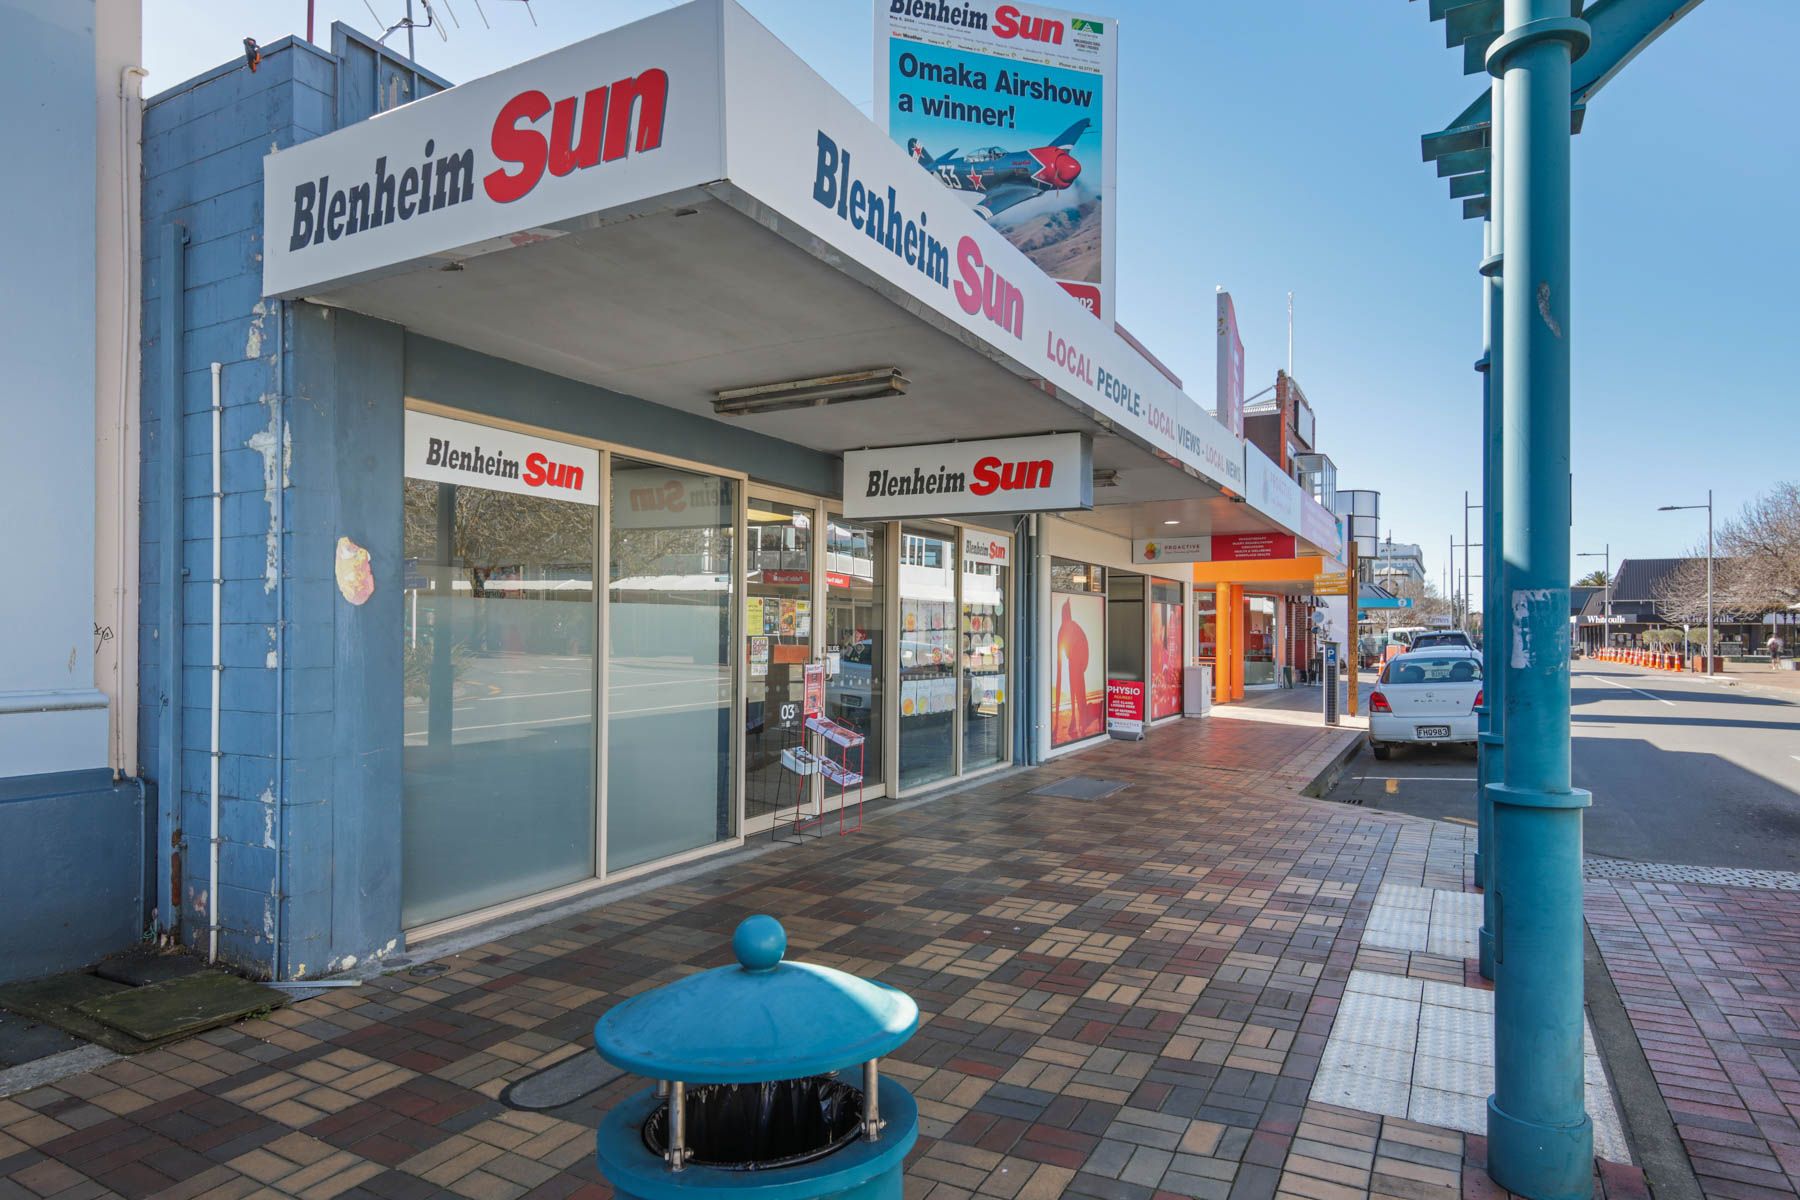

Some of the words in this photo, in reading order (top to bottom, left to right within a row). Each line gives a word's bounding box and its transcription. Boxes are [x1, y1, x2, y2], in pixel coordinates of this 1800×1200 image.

[991, 5, 1065, 46] Sun
[898, 52, 987, 91] Omaka
[994, 69, 1093, 108] Airshow
[898, 92, 914, 112] a
[921, 95, 1016, 129] winner!
[289, 139, 474, 252] Blenheim
[483, 68, 669, 203] Sun
[812, 129, 949, 289] Blenheim
[953, 235, 1024, 340] Sun
[1047, 330, 1094, 386] LOCAL
[1097, 366, 1140, 417] PEOPLE
[1148, 403, 1175, 441] LOCAL
[1177, 424, 1201, 457] VIEWS
[1206, 444, 1225, 473] LOCAL
[1226, 458, 1241, 483] NEWS
[426, 437, 519, 479] Blenheim
[522, 452, 584, 491] Sun
[866, 465, 965, 497] Blenheim
[969, 456, 1054, 496] Sun
[966, 540, 988, 556] Blenheim
[989, 541, 1006, 560] Sun
[1327, 649, 1335, 658] P
[1106, 685, 1141, 696] PHYSIO
[781, 704, 795, 720] 03
[1418, 728, 1448, 736] FHQ983
